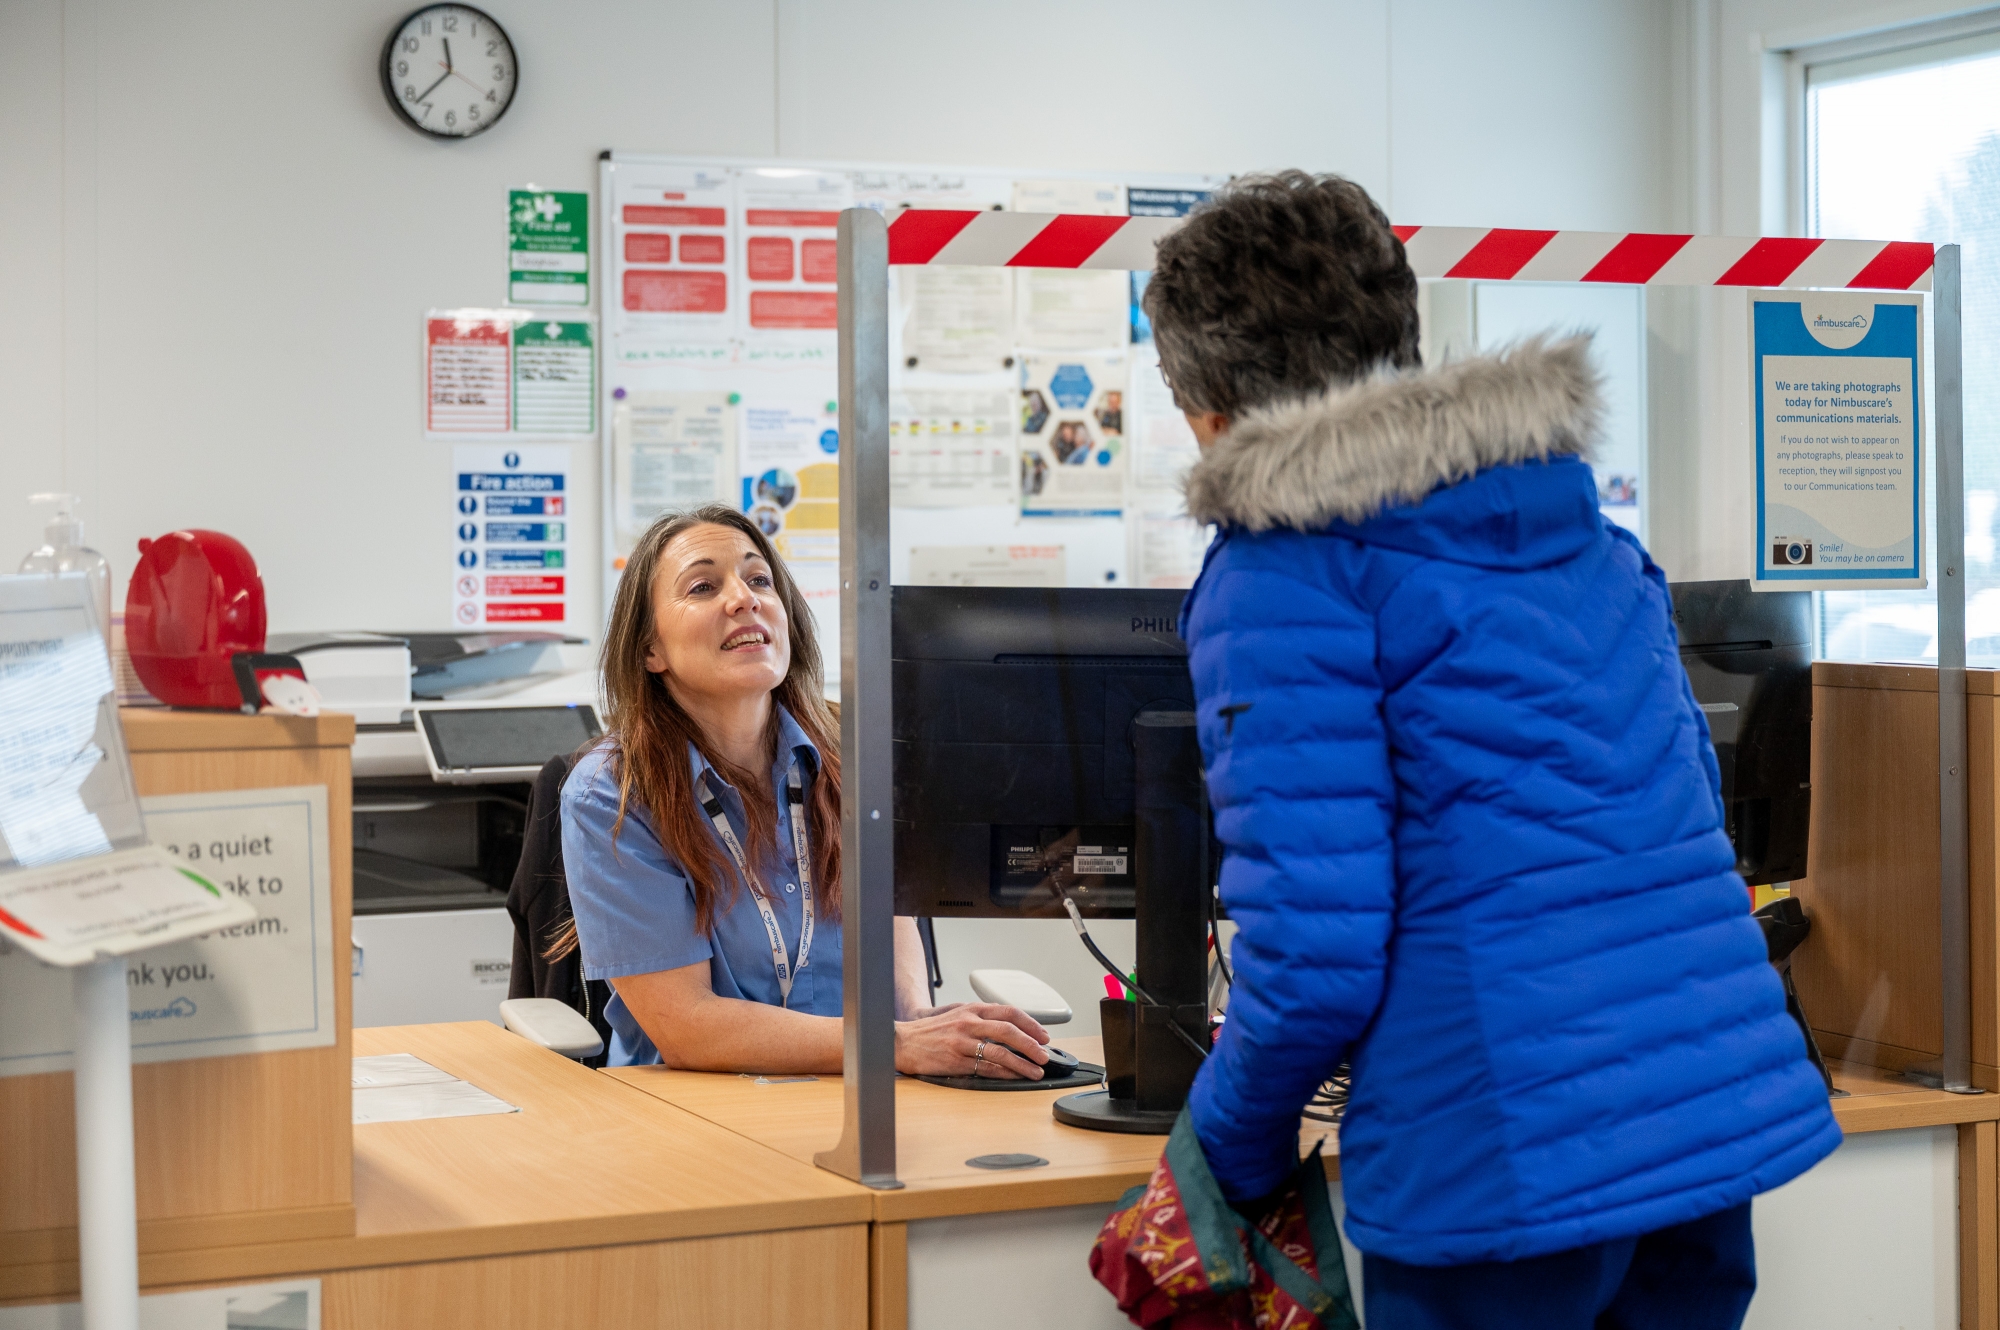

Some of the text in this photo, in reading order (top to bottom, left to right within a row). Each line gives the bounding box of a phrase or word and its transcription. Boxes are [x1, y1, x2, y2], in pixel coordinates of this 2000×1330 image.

[421, 19, 432, 36] 11
[442, 15, 458, 32] 12
[470, 22, 477, 38] 1
[402, 36, 420, 53] 10
[485, 39, 497, 57] 2
[397, 60, 409, 77] 9
[492, 63, 504, 81] 3
[404, 84, 416, 102] 8
[485, 88, 496, 102] 4
[421, 102, 433, 118] 7
[444, 110, 457, 127] 6
[468, 103, 480, 120] 5
[1813, 317, 1860, 328] nimbuscare
[1775, 381, 1791, 391] We
[1811, 382, 1841, 393] taking
[1843, 382, 1901, 394] photographs
[1785, 397, 1892, 409] today for Nimbuscare’s
[1776, 414, 1902, 424] communications materials.
[1780, 435, 1786, 444] If
[1788, 437, 1802, 445] you
[1804, 435, 1814, 444] do
[1816, 436, 1829, 444] not
[1831, 435, 1849, 444] wish
[1851, 436, 1860, 444] to
[1861, 437, 1888, 446] appear
[1776, 451, 1904, 462] any photographs, please speak to
[1779, 467, 1902, 477] reception, they will signpost you
[471, 474, 554, 490] Fire action
[1809, 482, 1874, 491] Communications
[1875, 483, 1897, 491] team.
[1819, 543, 1844, 552] Smile!
[1819, 555, 1833, 563] You
[1835, 556, 1852, 564] may
[1854, 554, 1863, 562] be
[188, 843, 201, 860] a
[209, 835, 272, 862] quiet
[258, 875, 283, 895] to
[803, 882, 811, 900] NHS
[766, 914, 782, 954] nimbuscare
[801, 910, 811, 951] nimbuscare
[161, 964, 215, 988] you.
[777, 963, 787, 980] NHS
